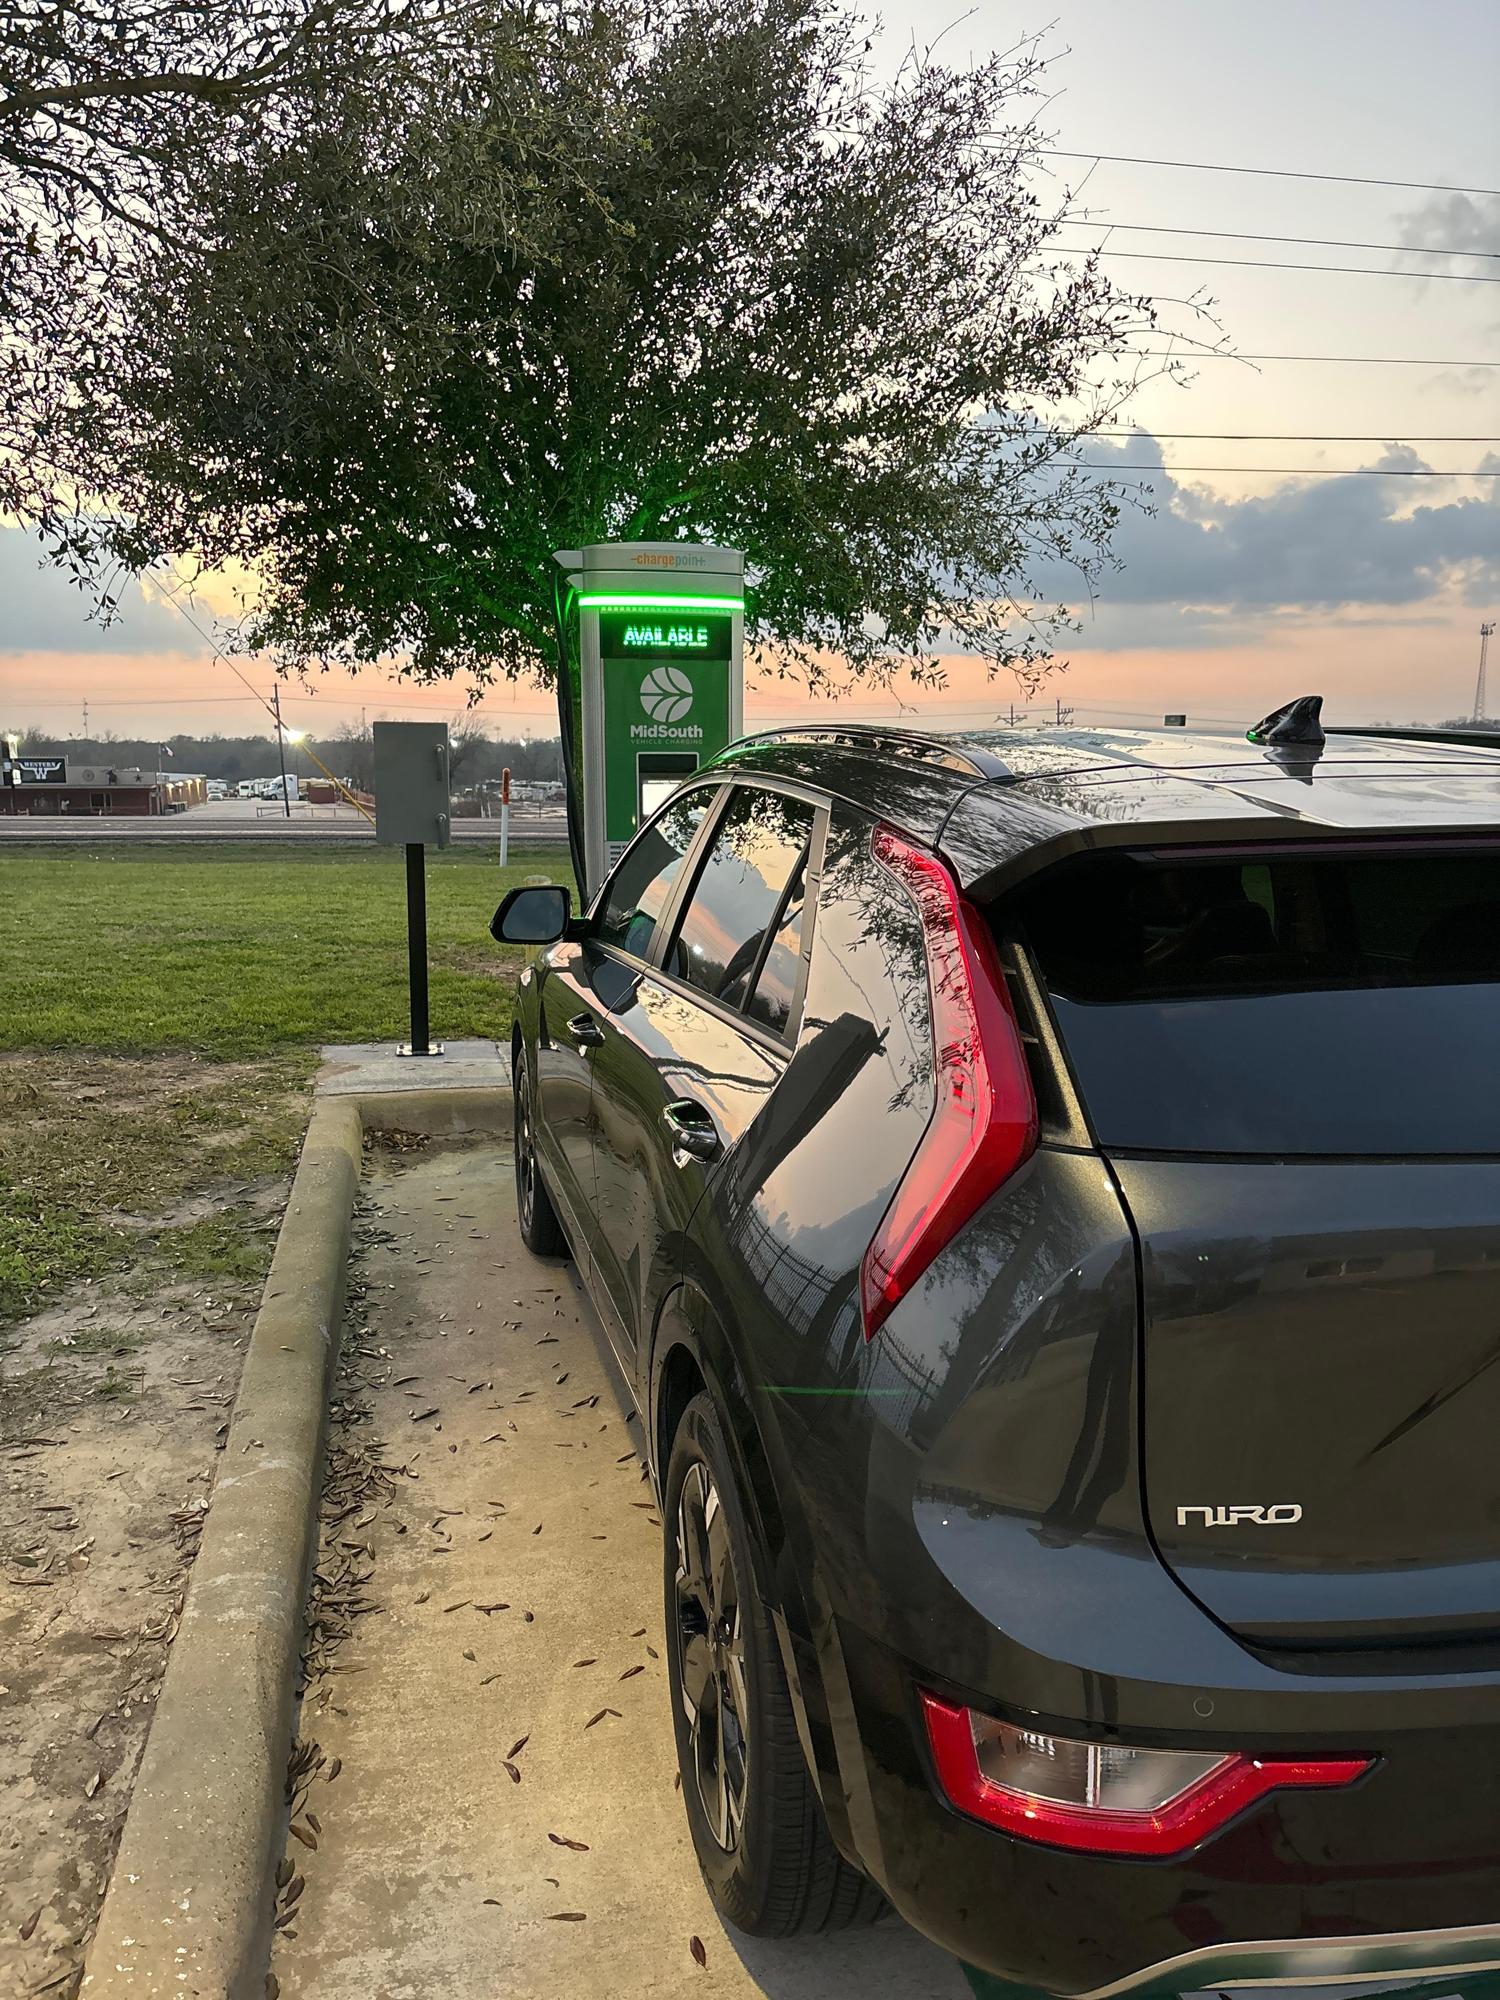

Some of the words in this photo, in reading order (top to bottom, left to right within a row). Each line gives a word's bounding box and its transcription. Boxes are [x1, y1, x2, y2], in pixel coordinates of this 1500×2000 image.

[623, 624, 708, 647] AVAILABLE
[630, 724, 703, 738] MidSouth
[1176, 1503, 1303, 1528] NIRO
